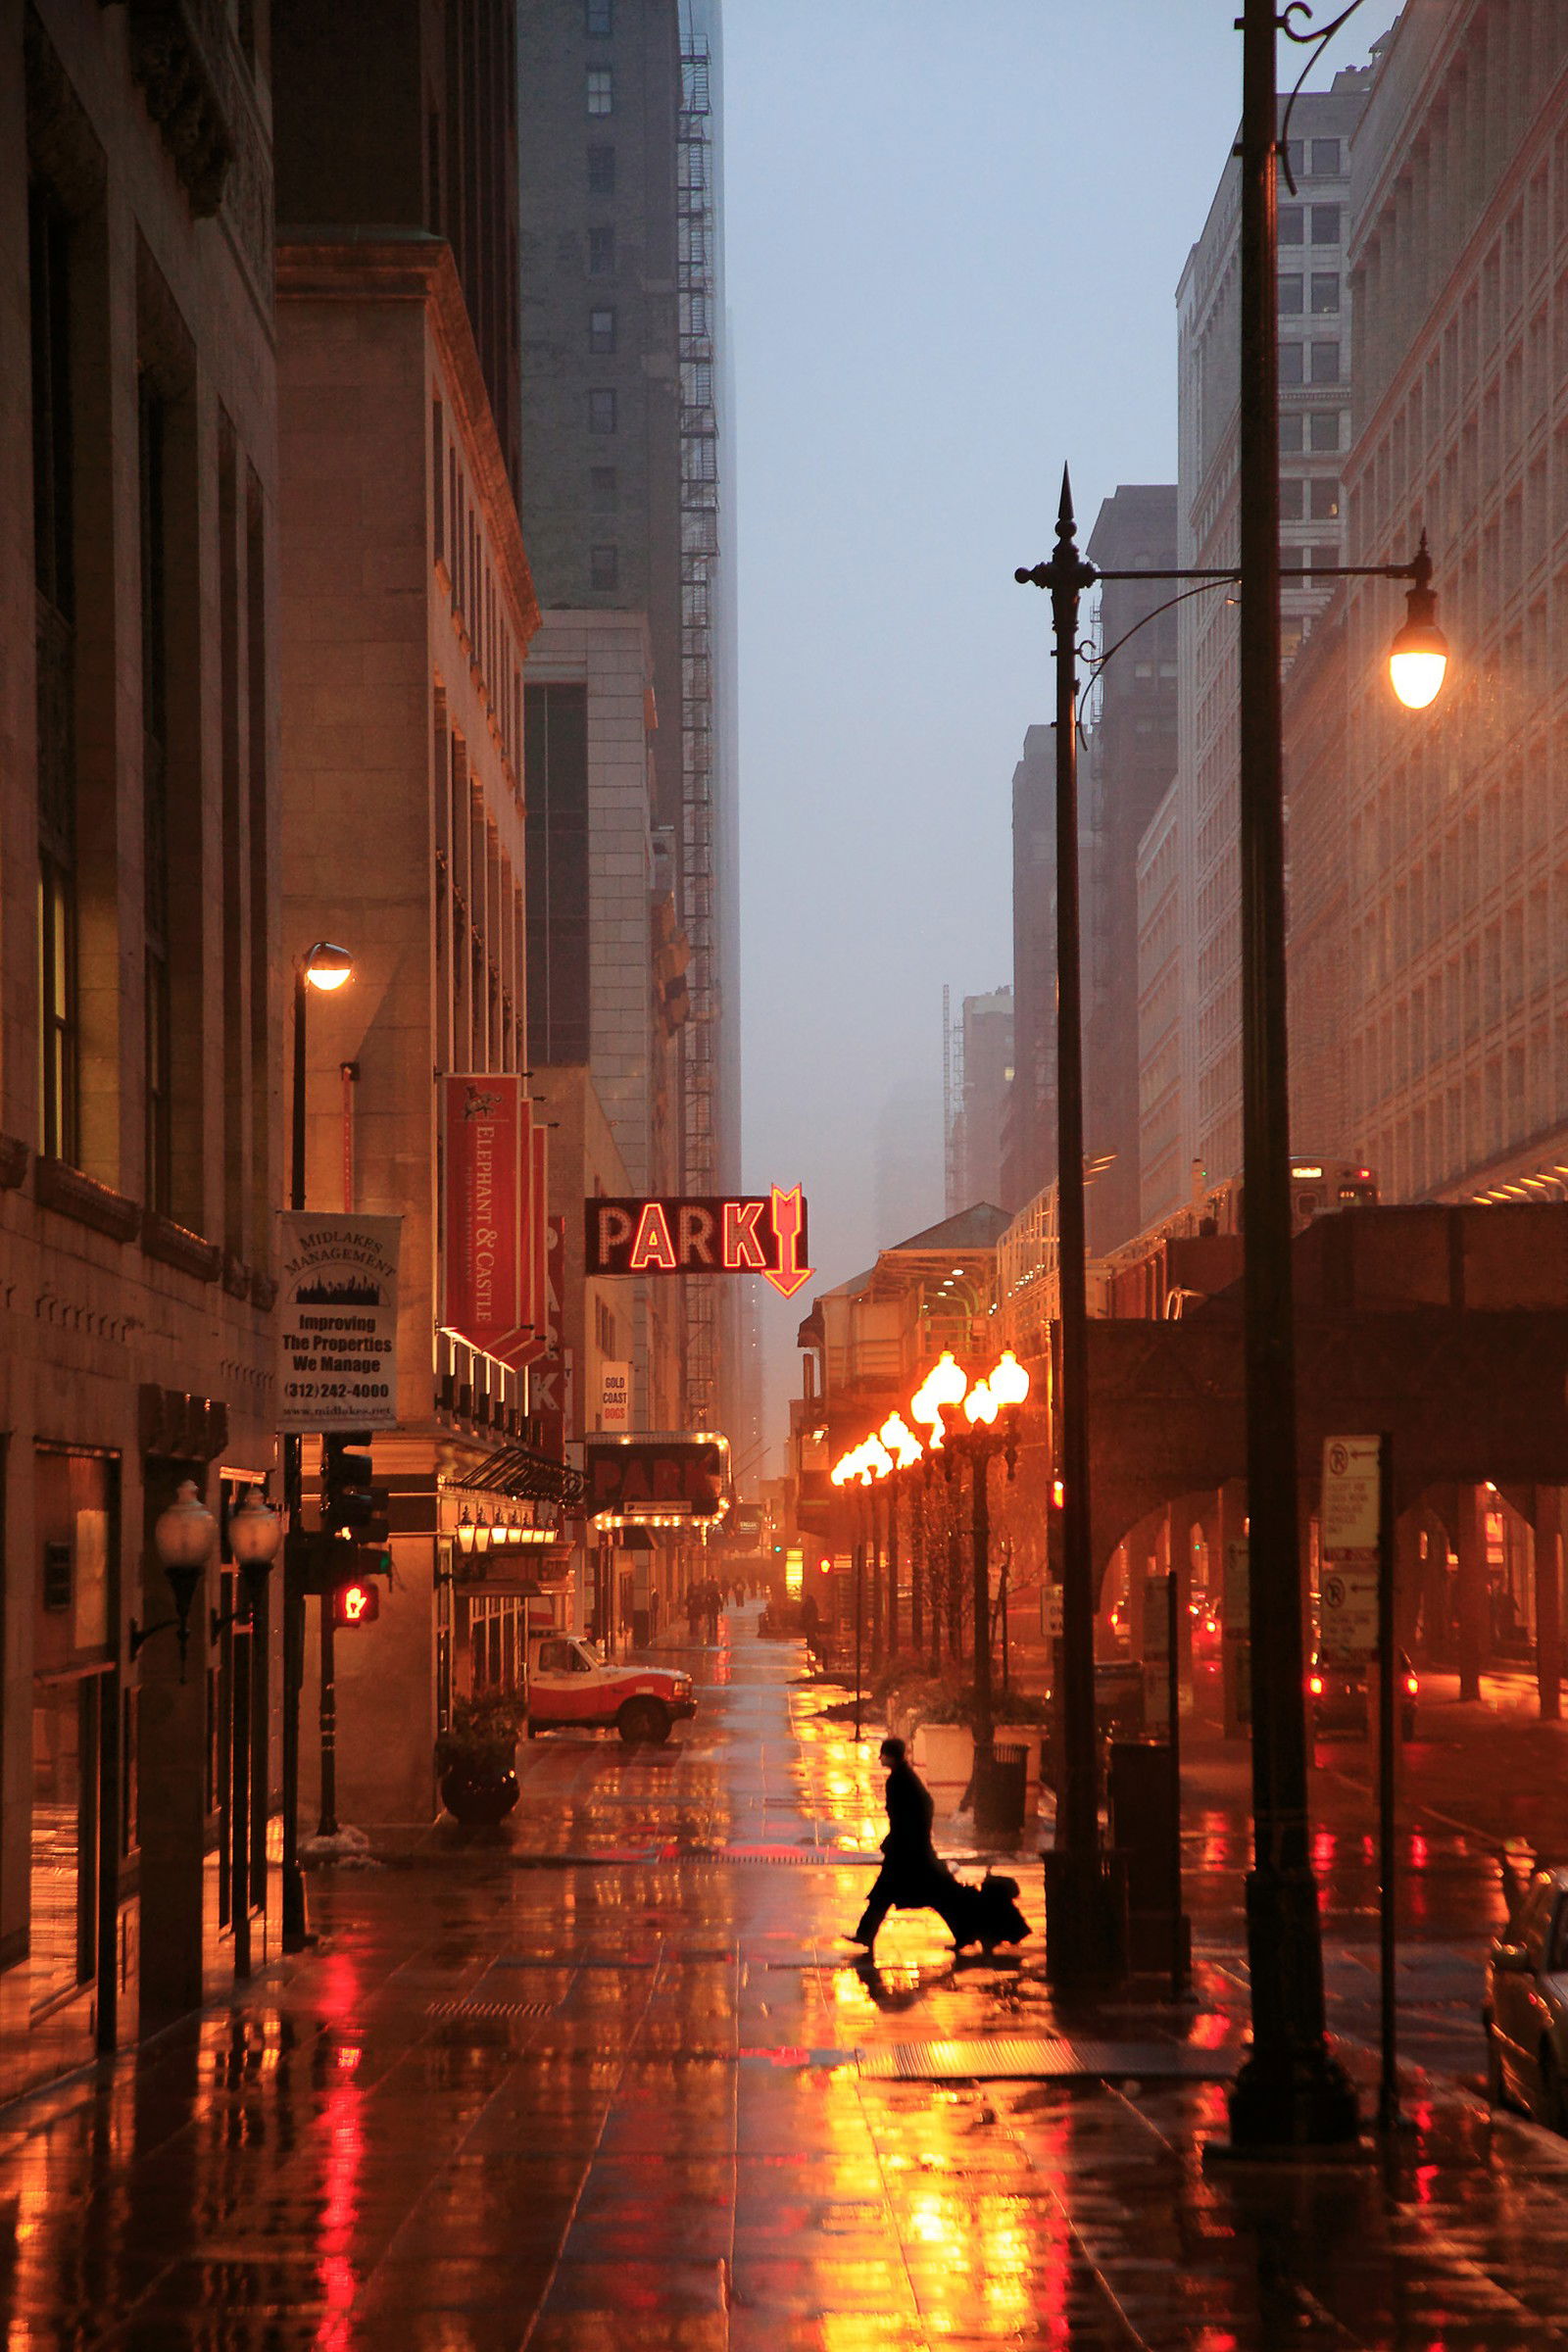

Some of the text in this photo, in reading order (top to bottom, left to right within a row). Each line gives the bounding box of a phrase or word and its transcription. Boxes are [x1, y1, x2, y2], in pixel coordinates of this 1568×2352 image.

[476, 1127, 498, 1322] ELEPHANT & CASTLE
[299, 1231, 384, 1254] MIDLAKES
[597, 1202, 767, 1268] PARK
[284, 1247, 397, 1277] MANAGEMENT
[299, 1315, 376, 1334] Improving
[282, 1334, 392, 1353] The Properties
[293, 1356, 381, 1374] We Manage
[606, 1377, 625, 1389] GOLD
[603, 1393, 627, 1404] COAST
[605, 1407, 625, 1420] DOGS
[594, 1459, 713, 1500] PARK
